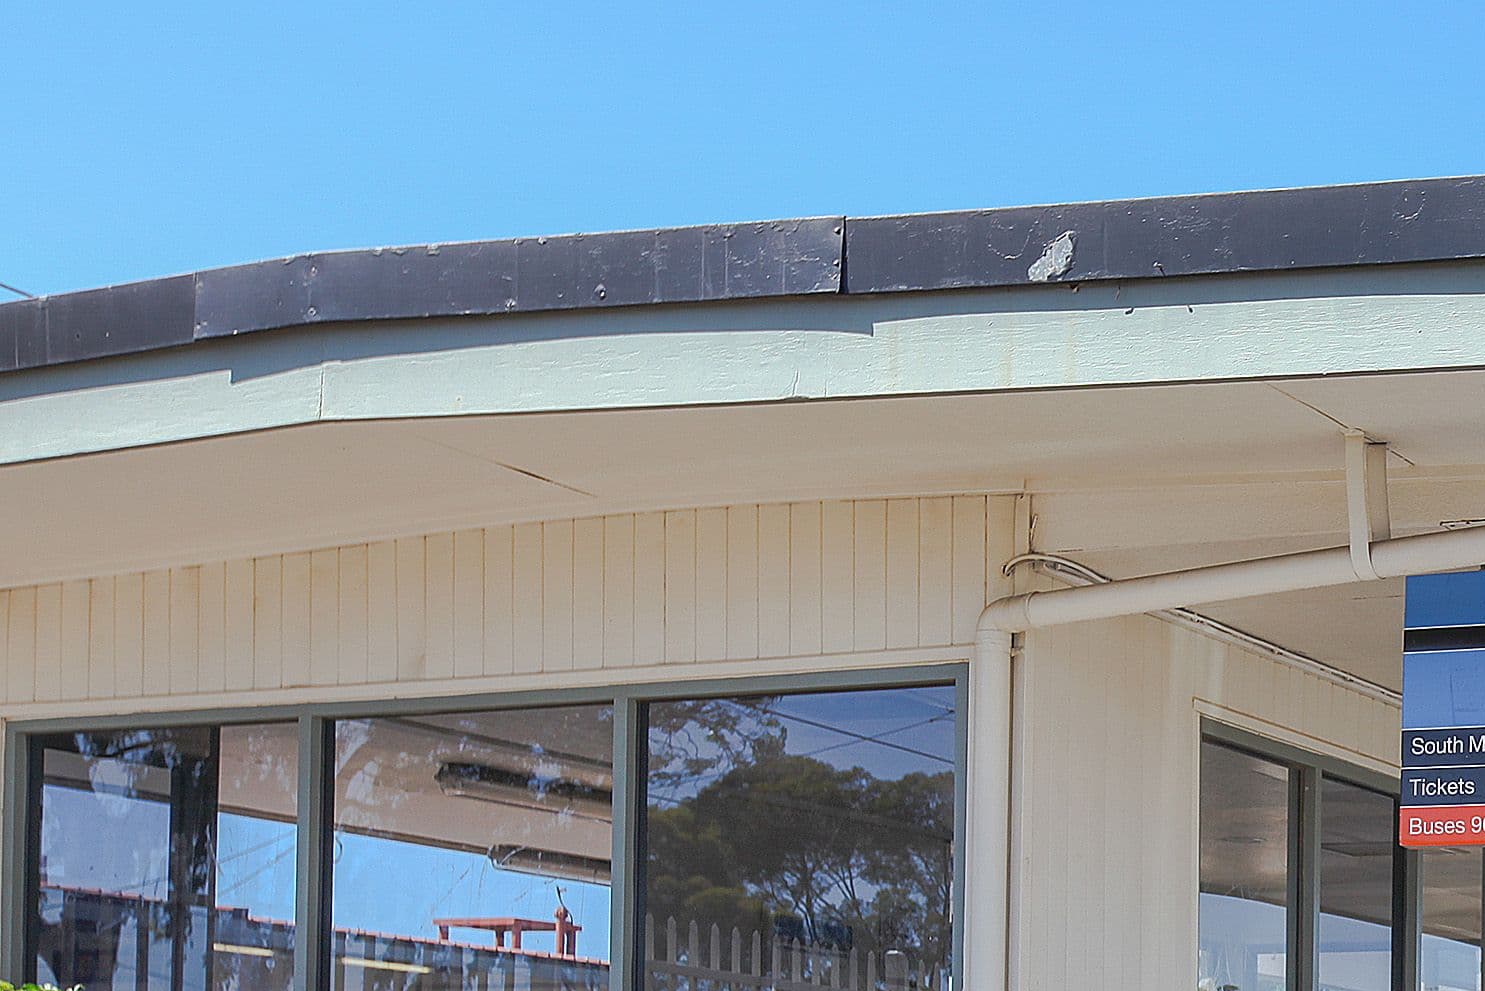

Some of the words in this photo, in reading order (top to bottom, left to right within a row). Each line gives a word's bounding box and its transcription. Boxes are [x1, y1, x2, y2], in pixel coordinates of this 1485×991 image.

[1411, 735, 1464, 755] South
[1409, 777, 1476, 796] Tickets
[1409, 817, 1466, 835] Buses
